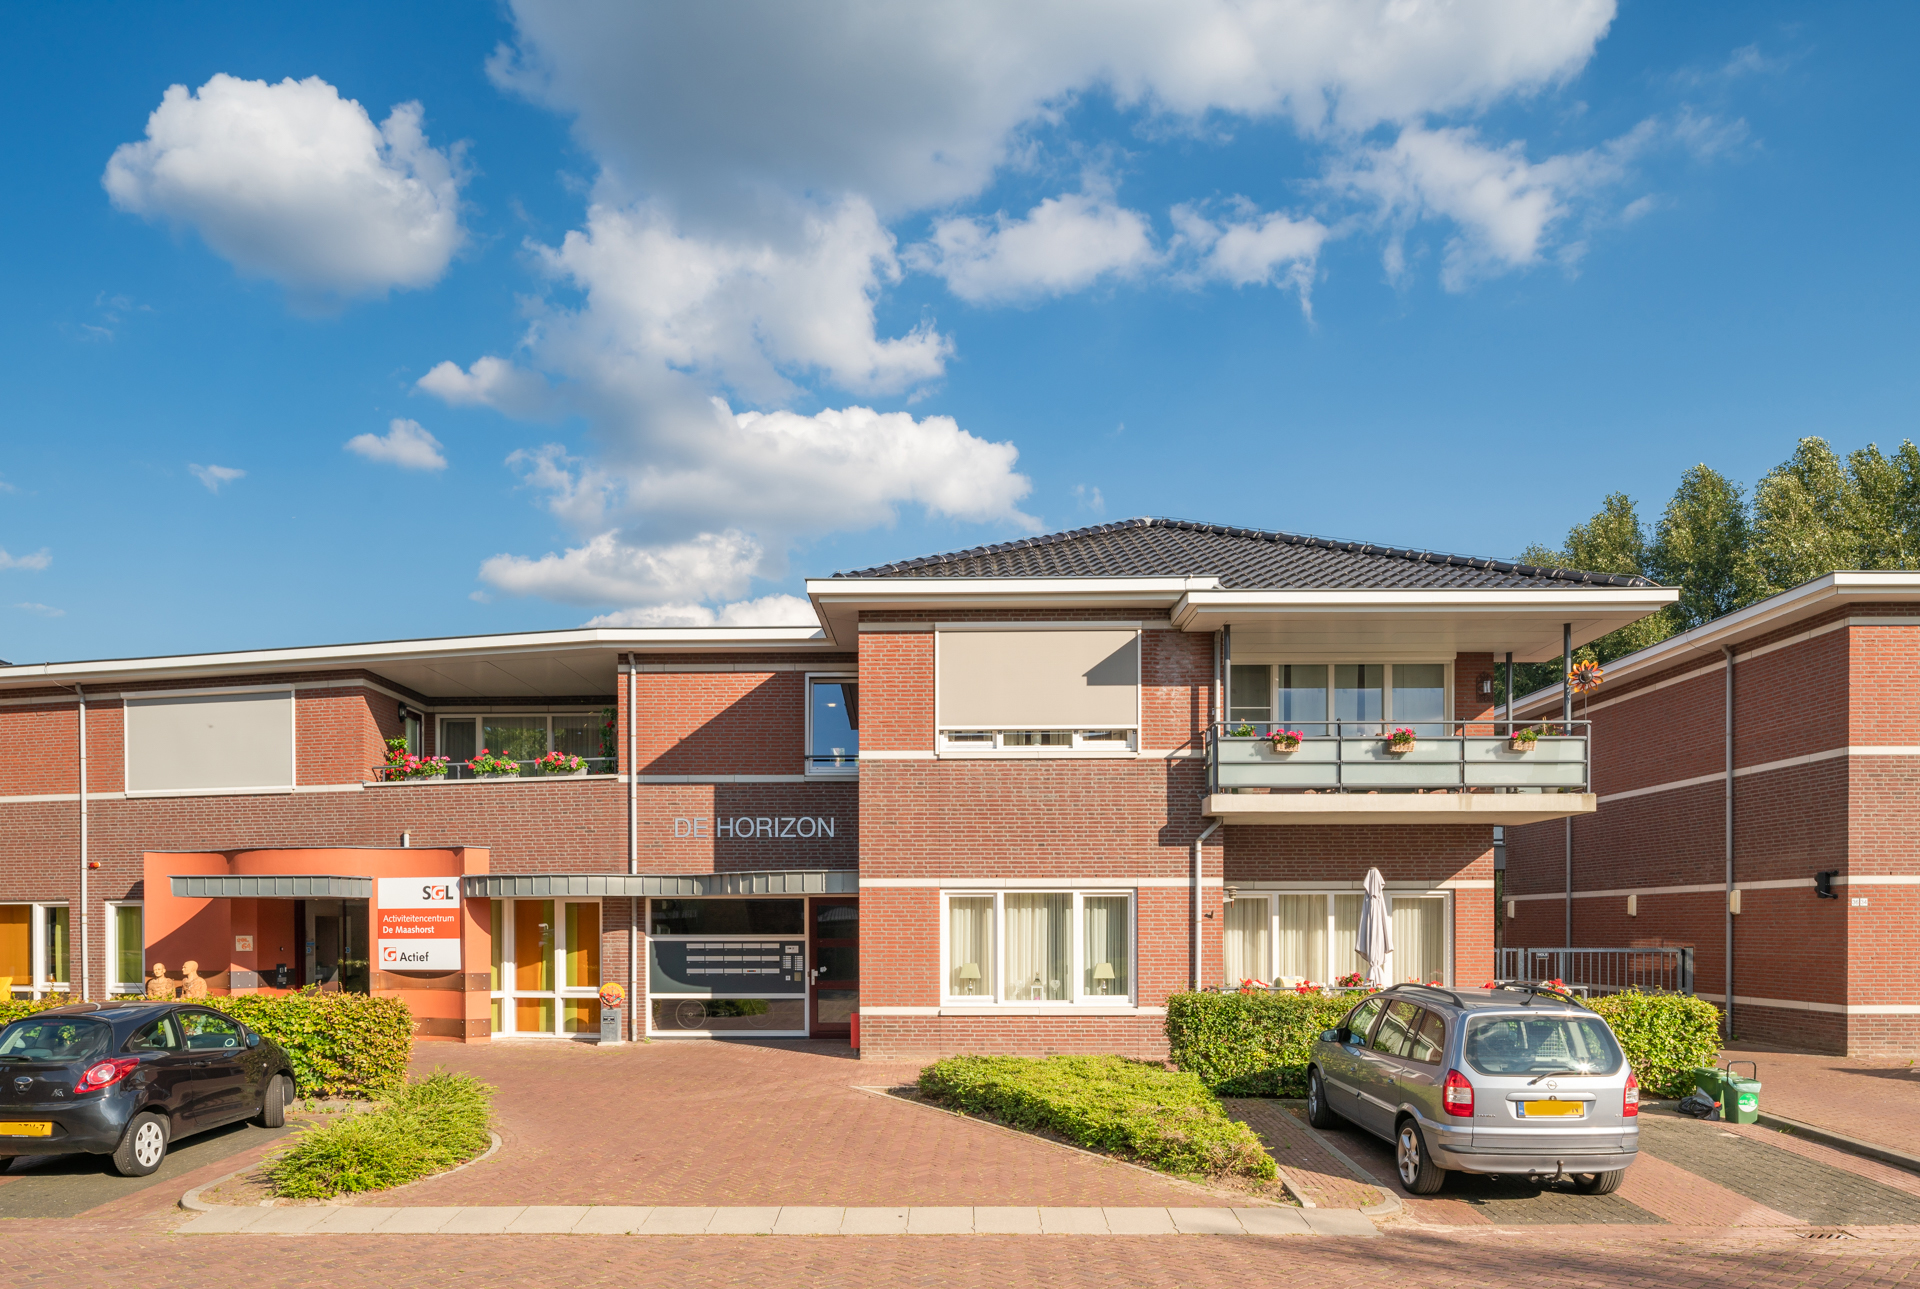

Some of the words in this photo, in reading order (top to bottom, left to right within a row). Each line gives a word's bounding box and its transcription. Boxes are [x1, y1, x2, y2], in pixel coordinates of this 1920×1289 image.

[674, 817, 708, 838] DE
[717, 816, 834, 838] HORIZON
[422, 885, 454, 900] SGL
[382, 914, 455, 923] Activiteitencentrum
[382, 926, 393, 934] De
[395, 925, 435, 934] Maashorst
[399, 951, 429, 962] Actief
